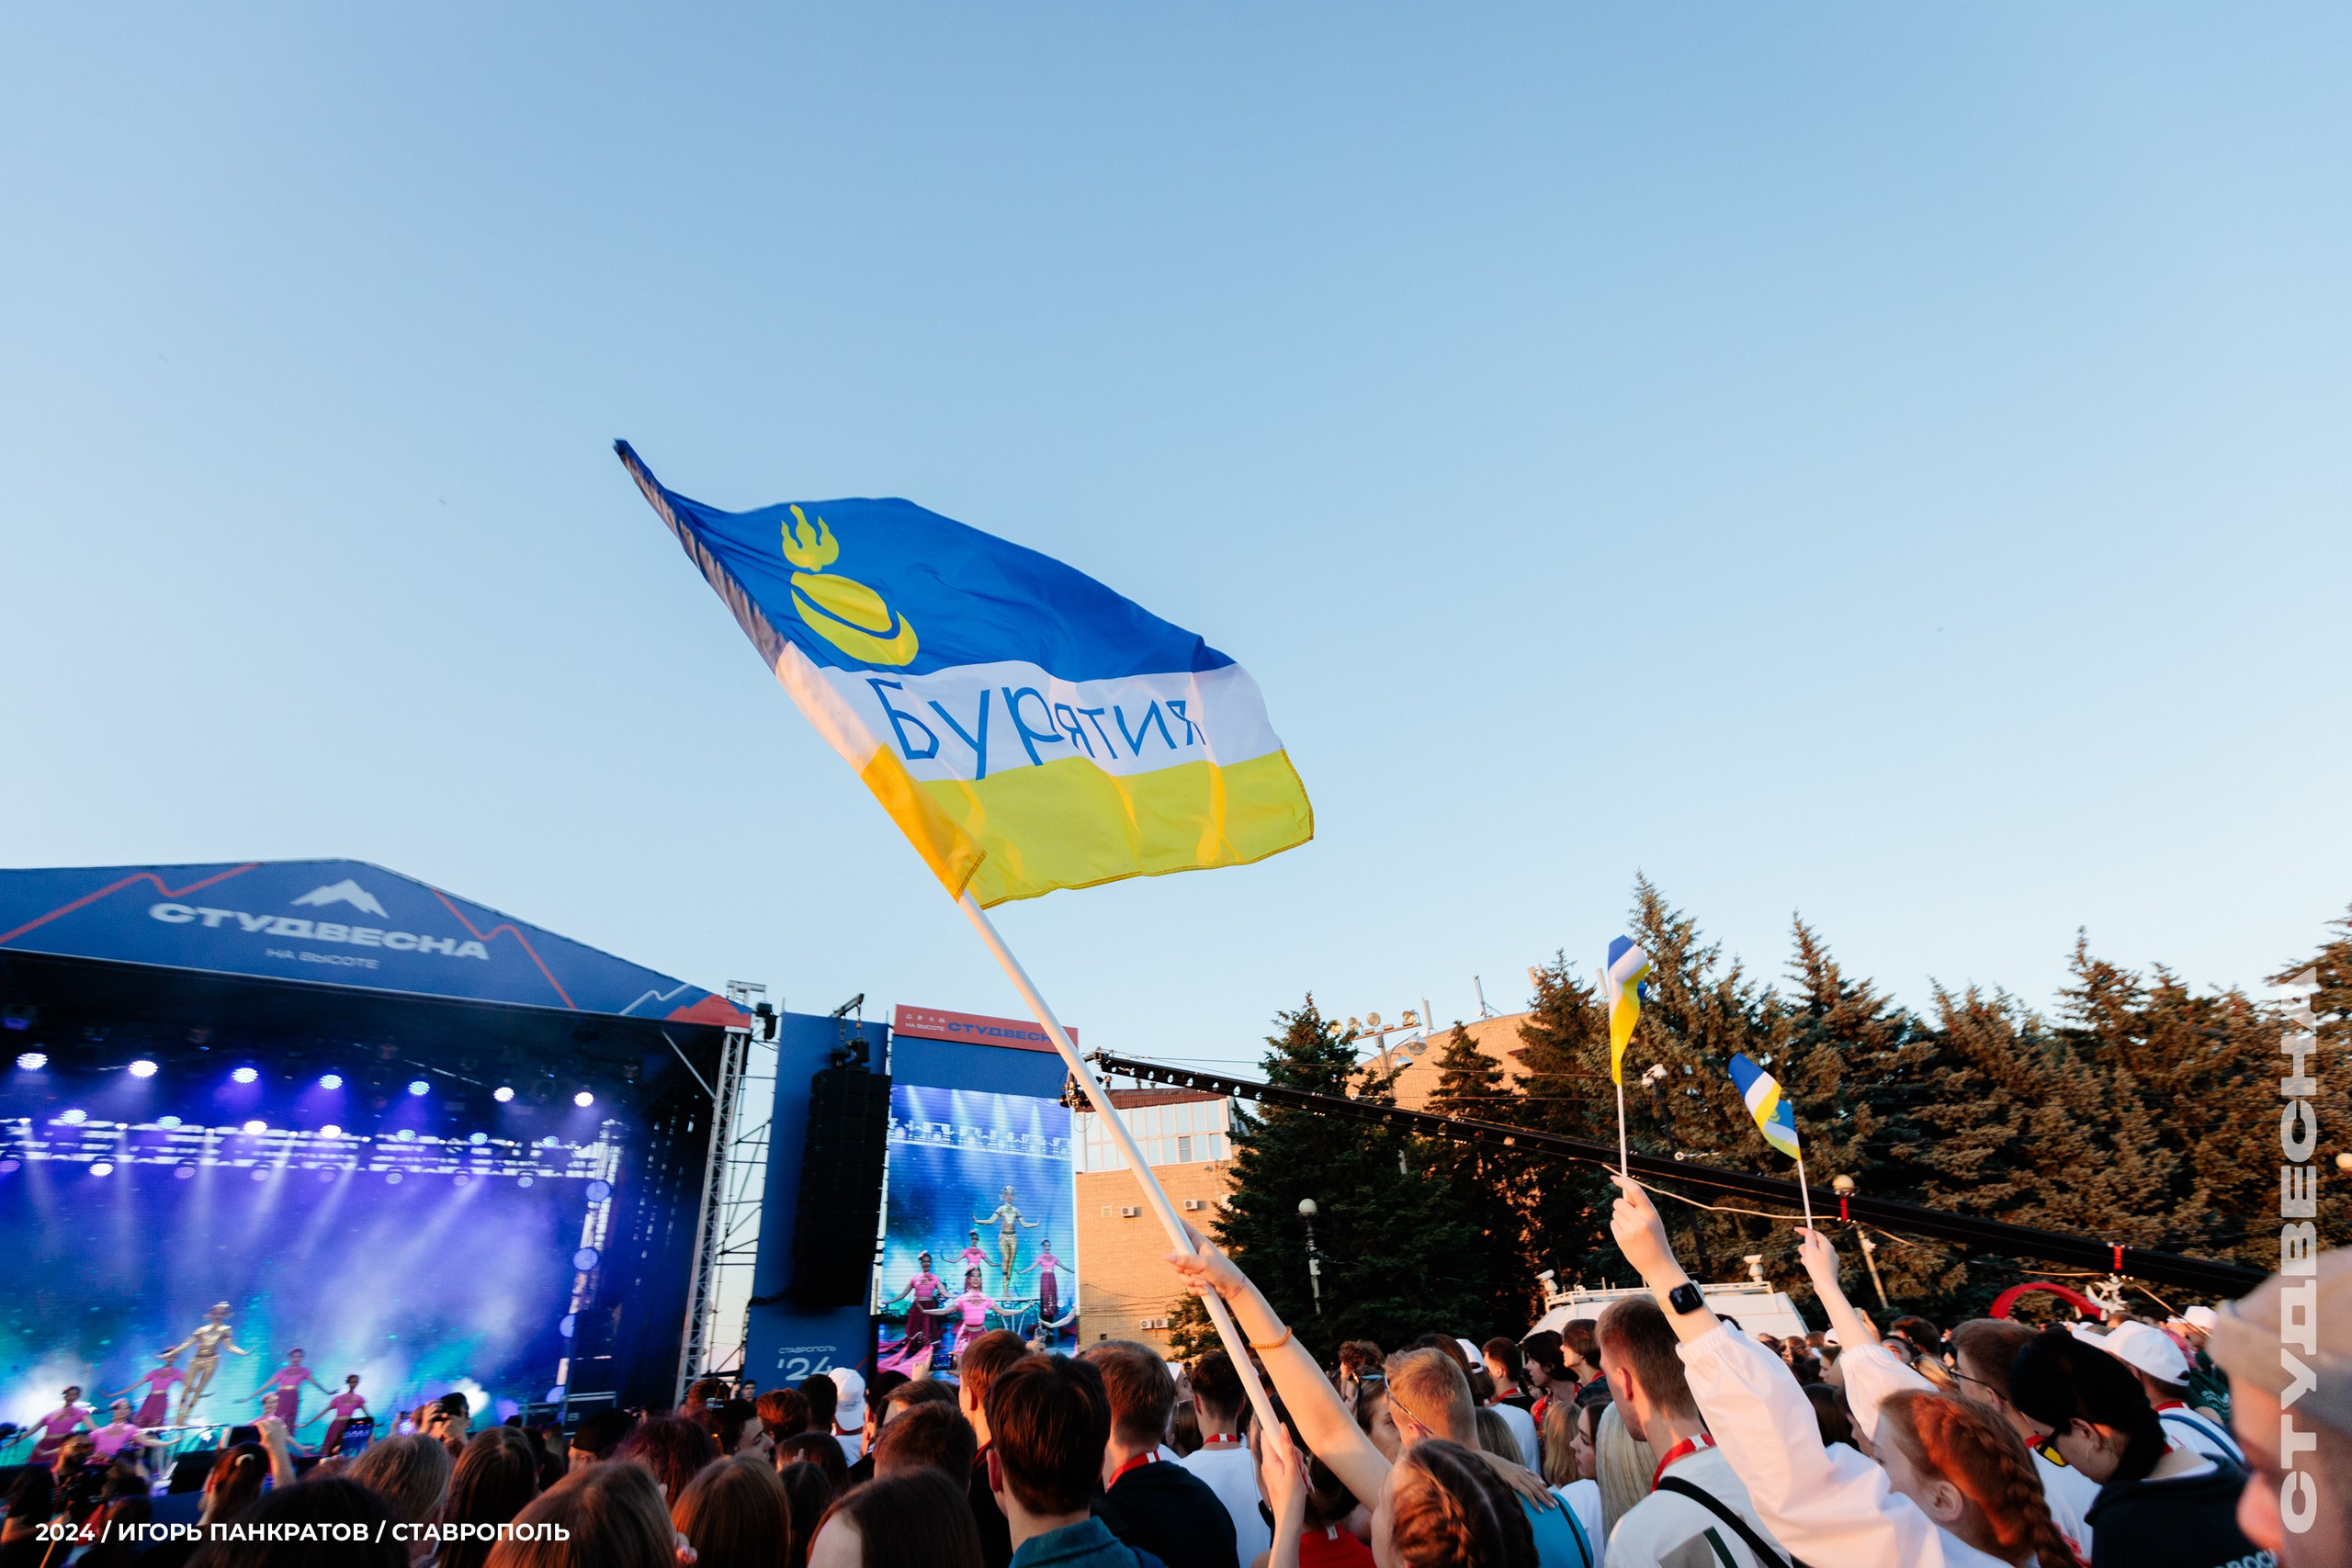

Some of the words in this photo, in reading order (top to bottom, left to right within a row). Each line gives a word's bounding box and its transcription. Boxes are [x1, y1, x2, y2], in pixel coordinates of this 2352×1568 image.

[149, 902, 491, 960] СТУДВЕСНА
[266, 948, 296, 960] НА
[299, 952, 379, 969] ВЫСОТЕ
[917, 1023, 944, 1032] ВЫСОТЕ
[947, 1022, 1052, 1043] СТУДВЕСН
[778, 1346, 837, 1354] СТАВРОПОЛЬ
[777, 1356, 832, 1381] '24
